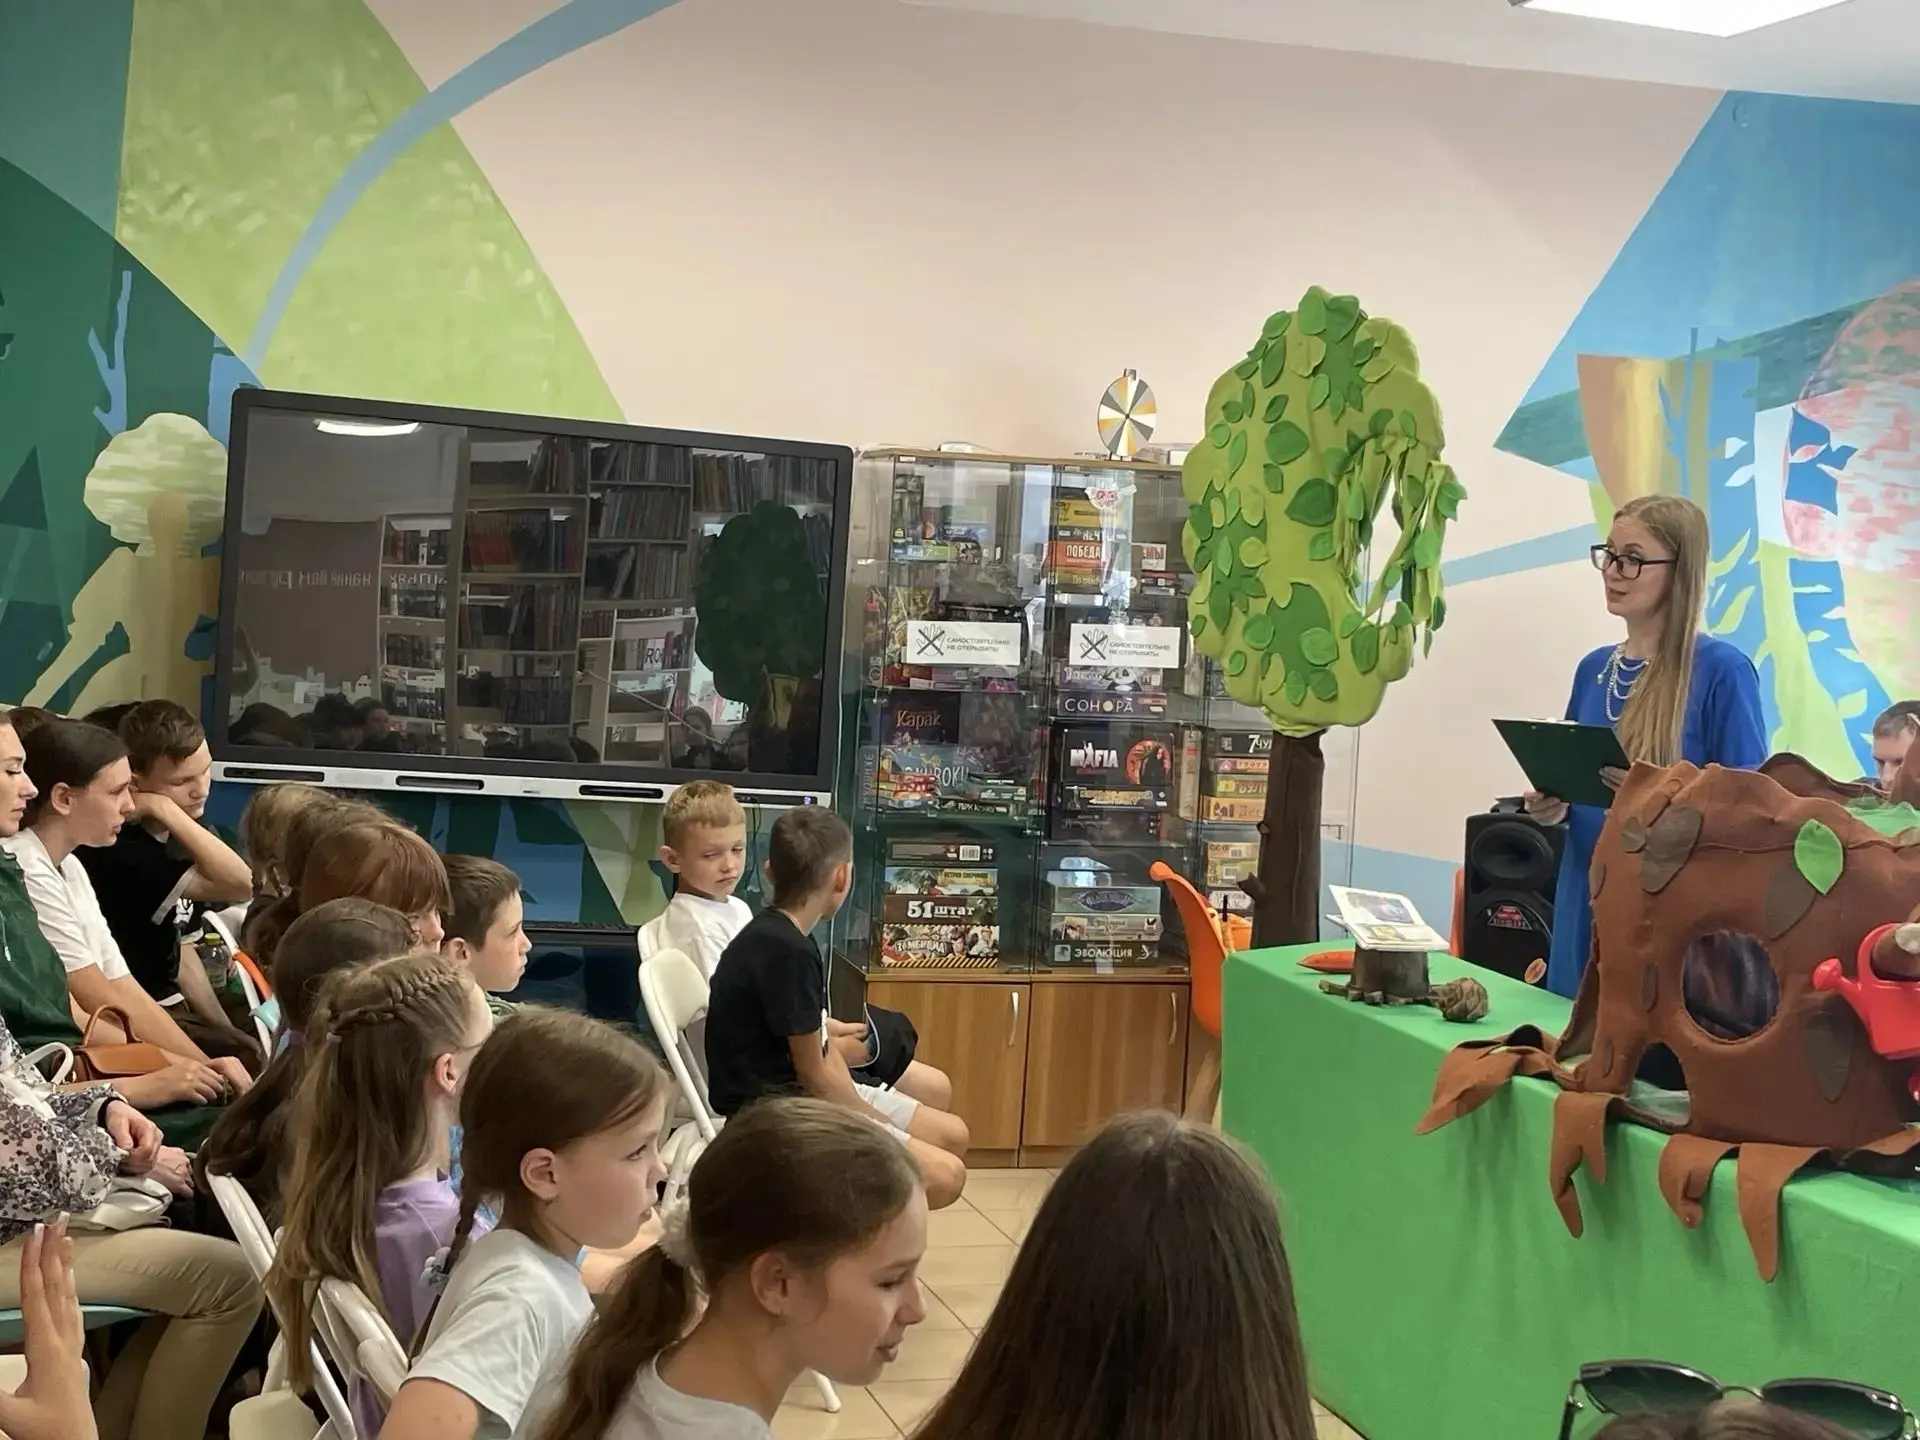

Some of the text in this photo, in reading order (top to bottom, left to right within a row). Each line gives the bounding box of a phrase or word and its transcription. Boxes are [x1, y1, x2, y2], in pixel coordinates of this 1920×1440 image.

[1066, 544, 1101, 558] ПОБЕДА
[907, 900, 934, 919] 51
[1074, 948, 1133, 958] ЭВОЛЮЦИЯ
